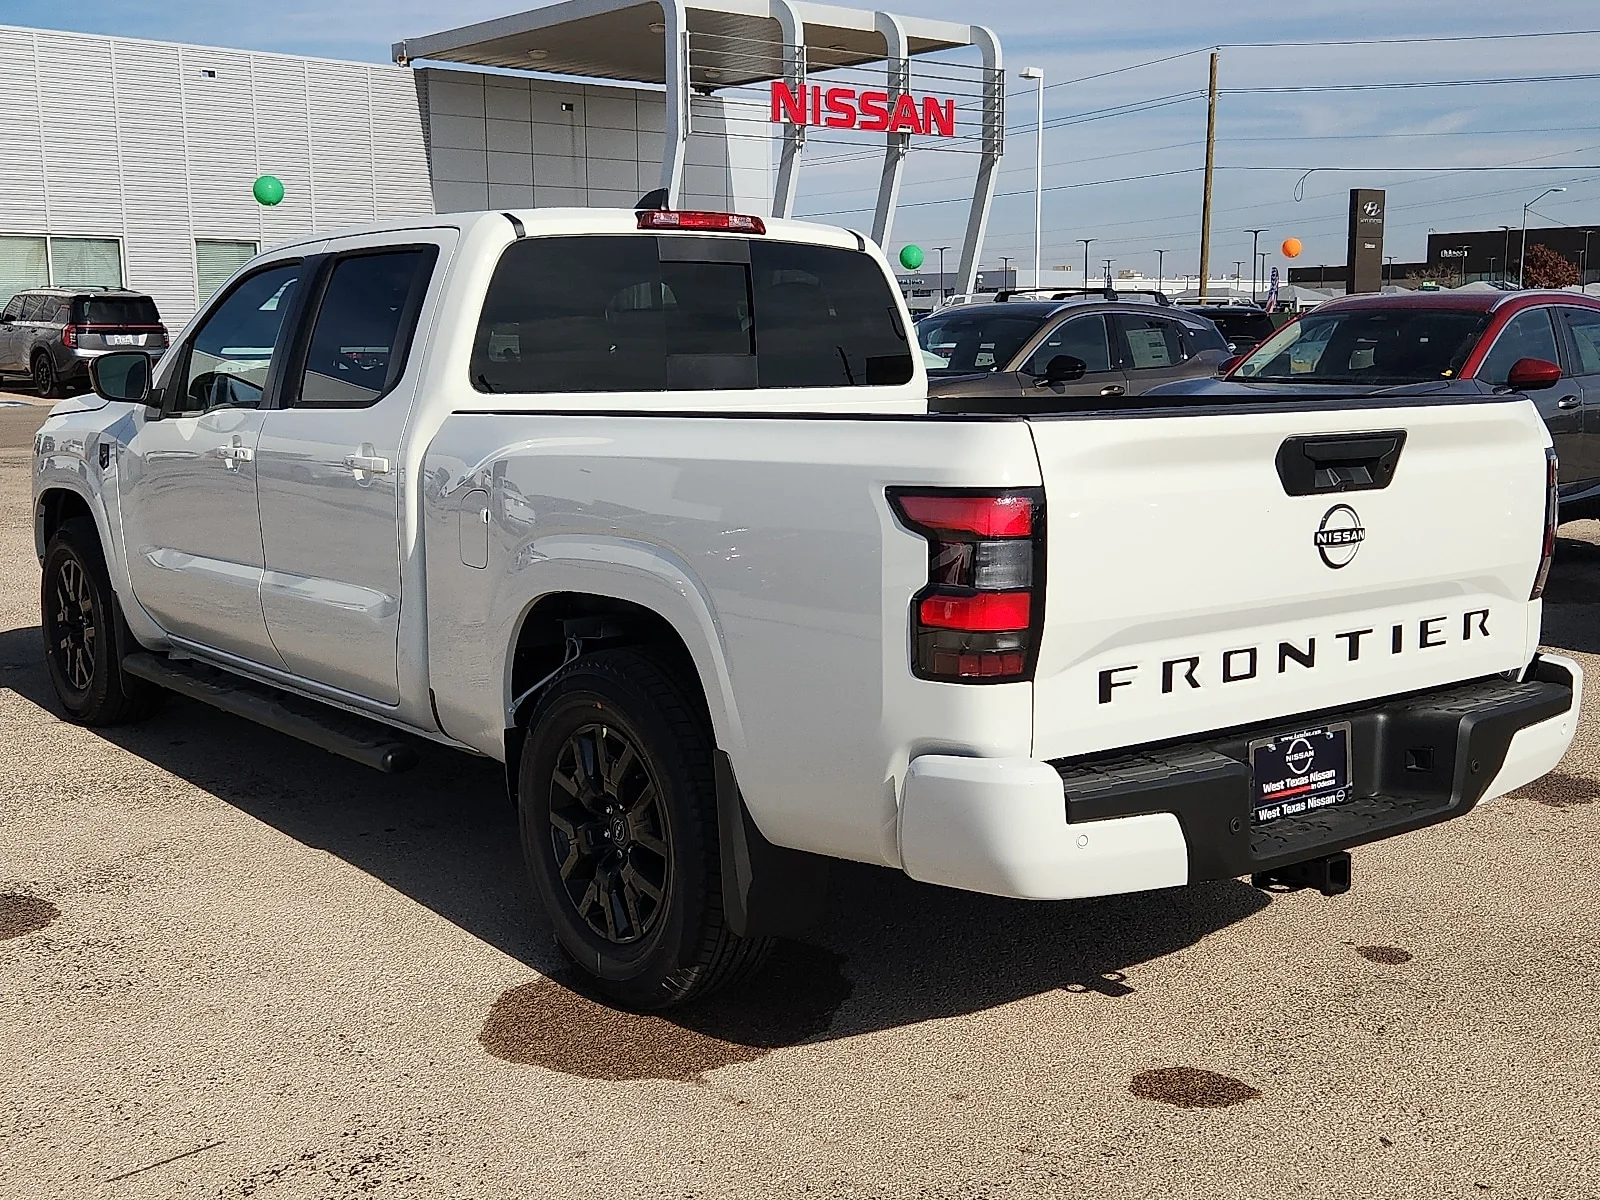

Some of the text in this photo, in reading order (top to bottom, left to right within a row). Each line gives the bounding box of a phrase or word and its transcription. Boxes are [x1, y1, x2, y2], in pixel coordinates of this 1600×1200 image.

[771, 82, 954, 137] NISSAN
[1316, 529, 1365, 545] NISSAN
[1098, 607, 1490, 705] FRONTIER
[1285, 750, 1315, 763] NISSAN
[1262, 769, 1336, 793] West Texas Nissan
[1258, 794, 1336, 821] West Texas Nissan
